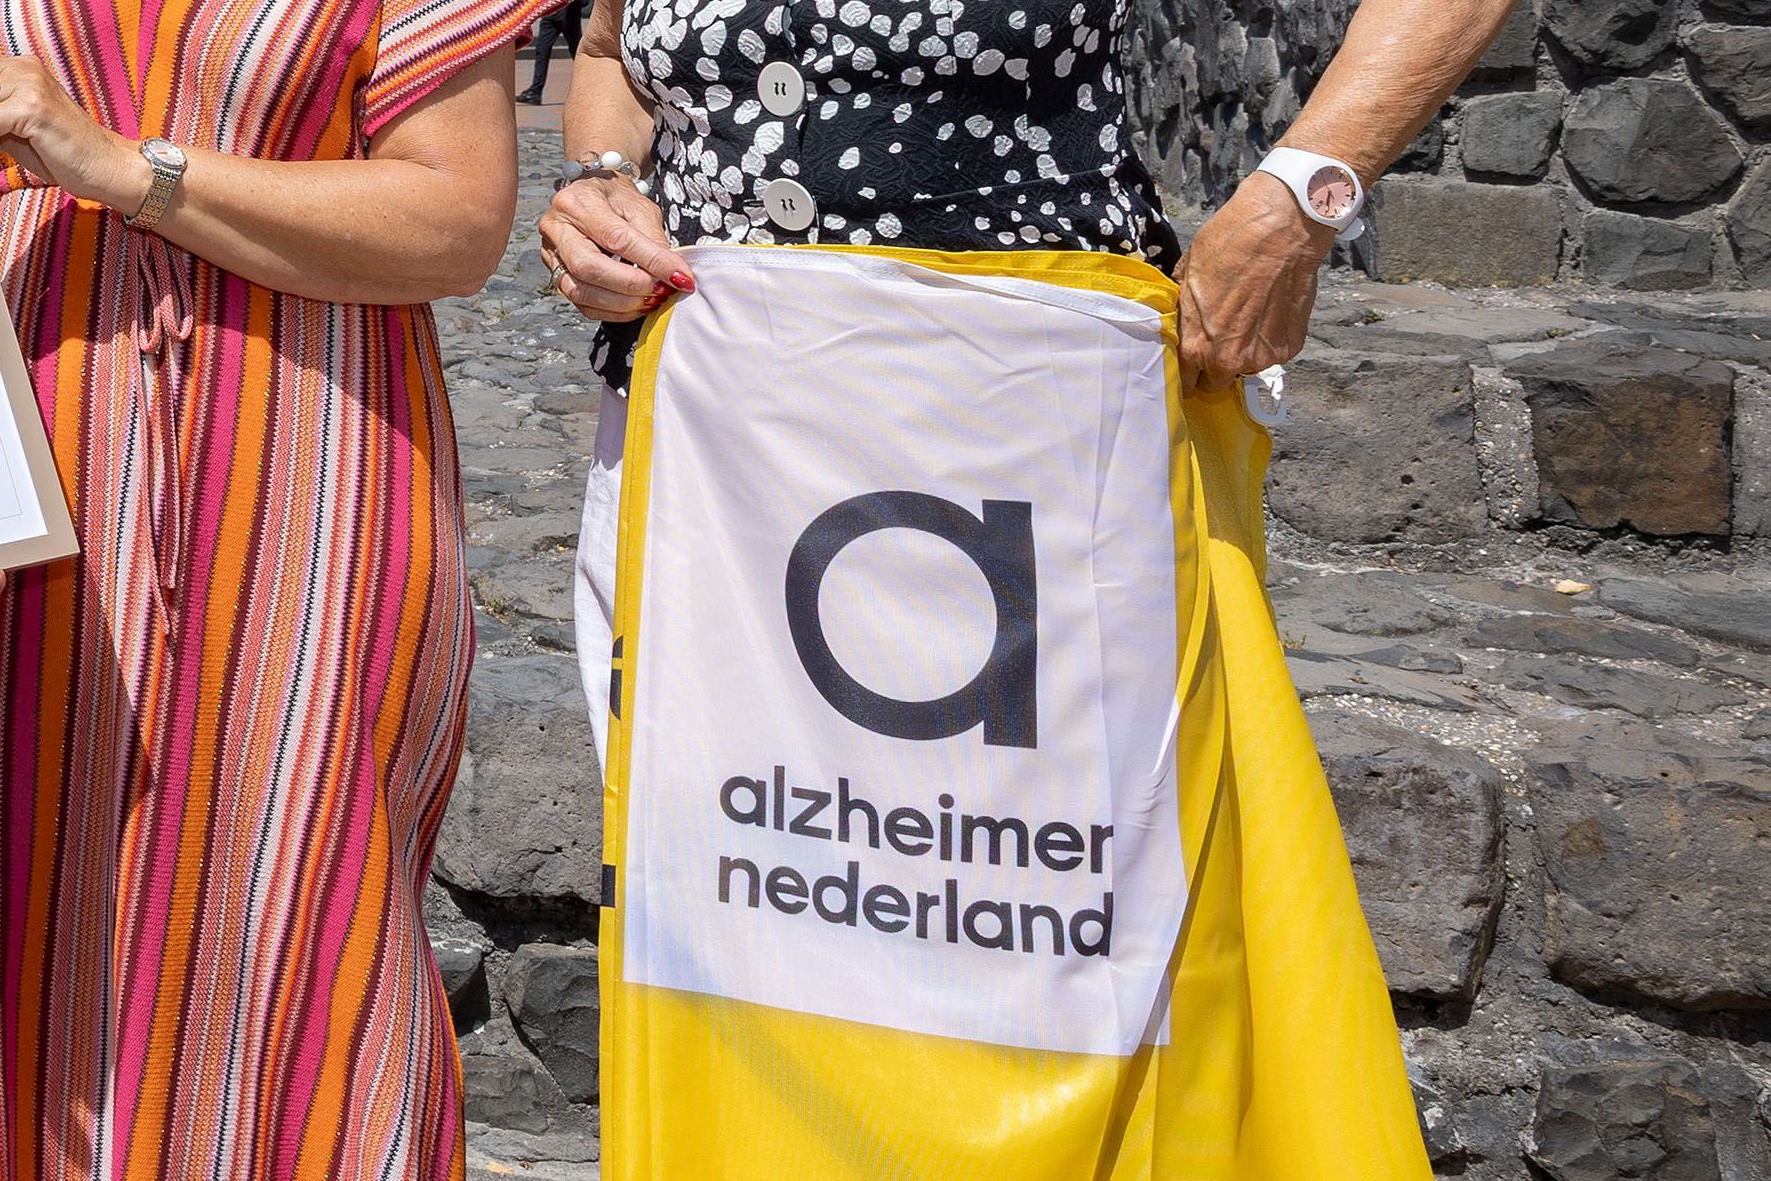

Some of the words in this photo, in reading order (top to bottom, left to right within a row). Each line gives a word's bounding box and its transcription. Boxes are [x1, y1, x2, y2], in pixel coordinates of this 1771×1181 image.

[784, 489, 1038, 749] a
[719, 765, 1114, 874] alzheimer
[718, 855, 1114, 957] nederland
